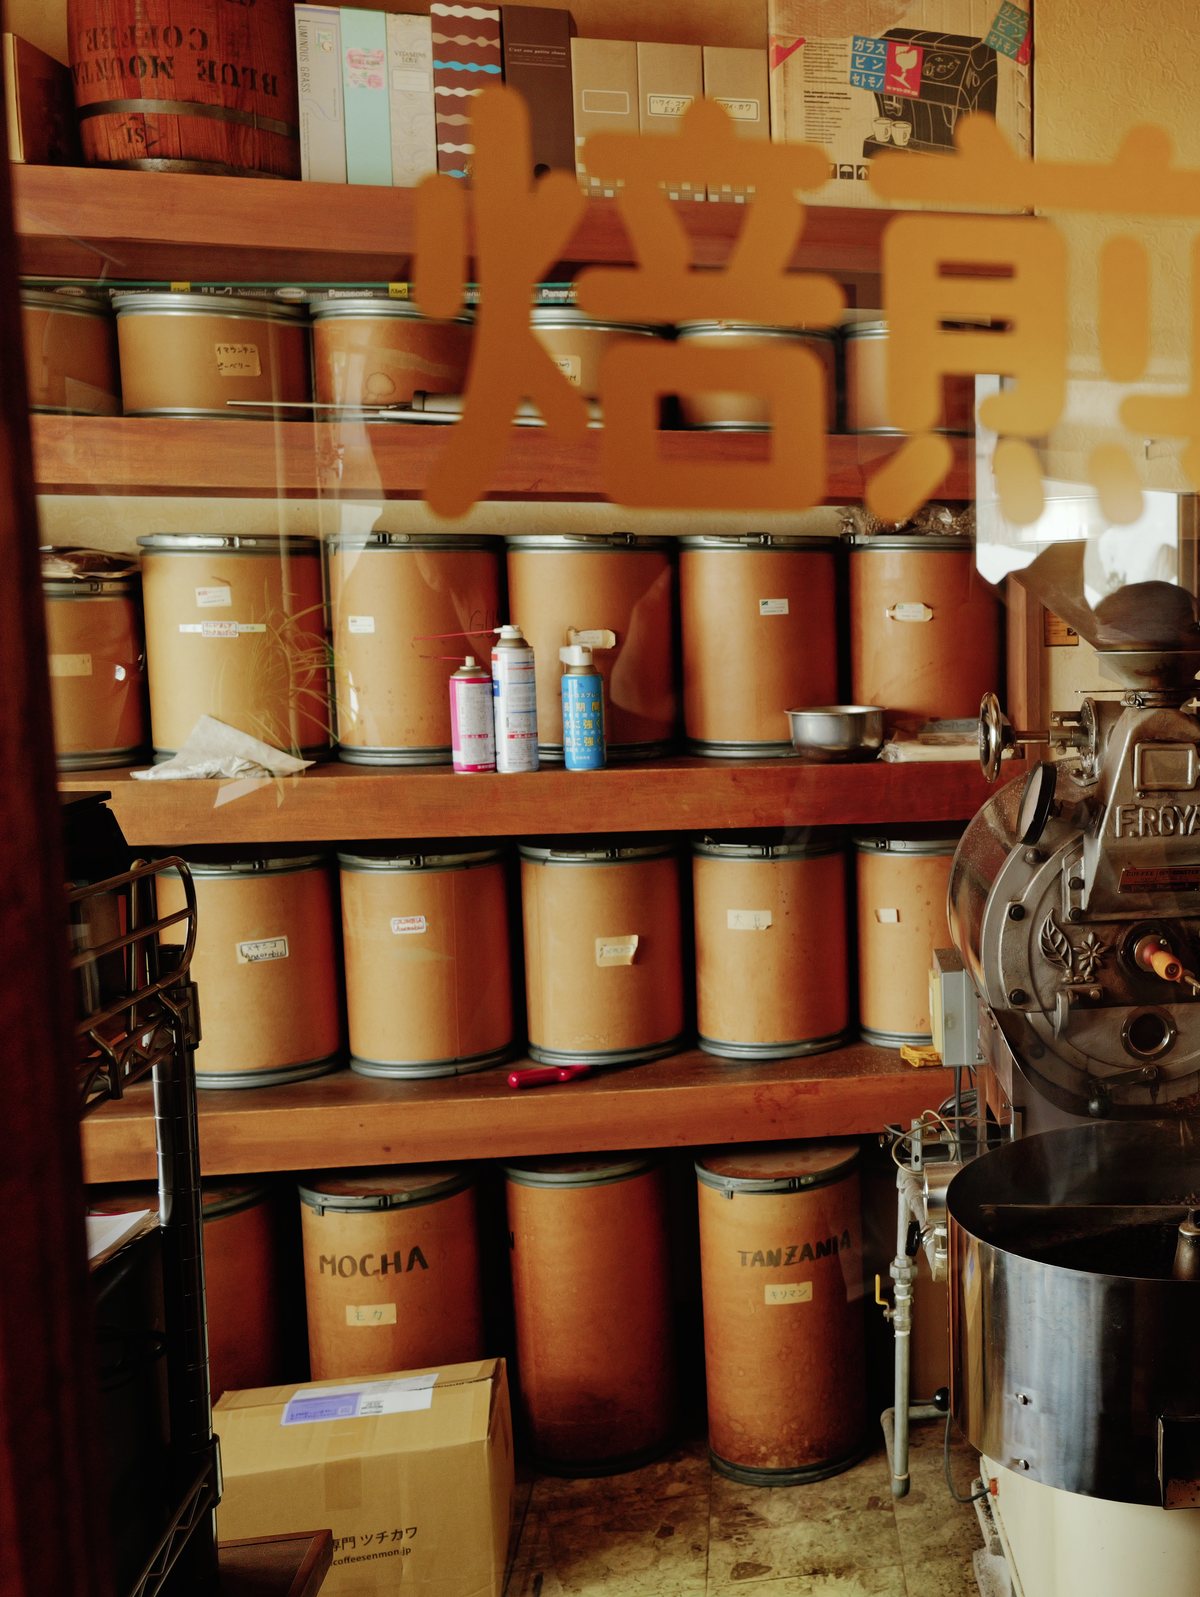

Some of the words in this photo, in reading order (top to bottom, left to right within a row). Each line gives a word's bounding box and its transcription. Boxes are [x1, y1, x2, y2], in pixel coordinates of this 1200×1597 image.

[997, 19, 1022, 37] ビン
[86, 26, 208, 52] COFFEE
[298, 18, 311, 62] LUMINOUS
[854, 39, 885, 55] ガラス
[855, 56, 883, 70] ビン
[196, 58, 279, 97] BLUE
[299, 66, 311, 93] GRASS
[852, 73, 884, 88] セトモノ
[328, 289, 374, 297] Panasonic
[737, 1228, 852, 1267] TANZANIA
[318, 1245, 430, 1279] MOCHA
[770, 1288, 808, 1300] キリマン
[354, 1310, 384, 1321] モカ
[360, 1526, 418, 1546] ツチカワ
